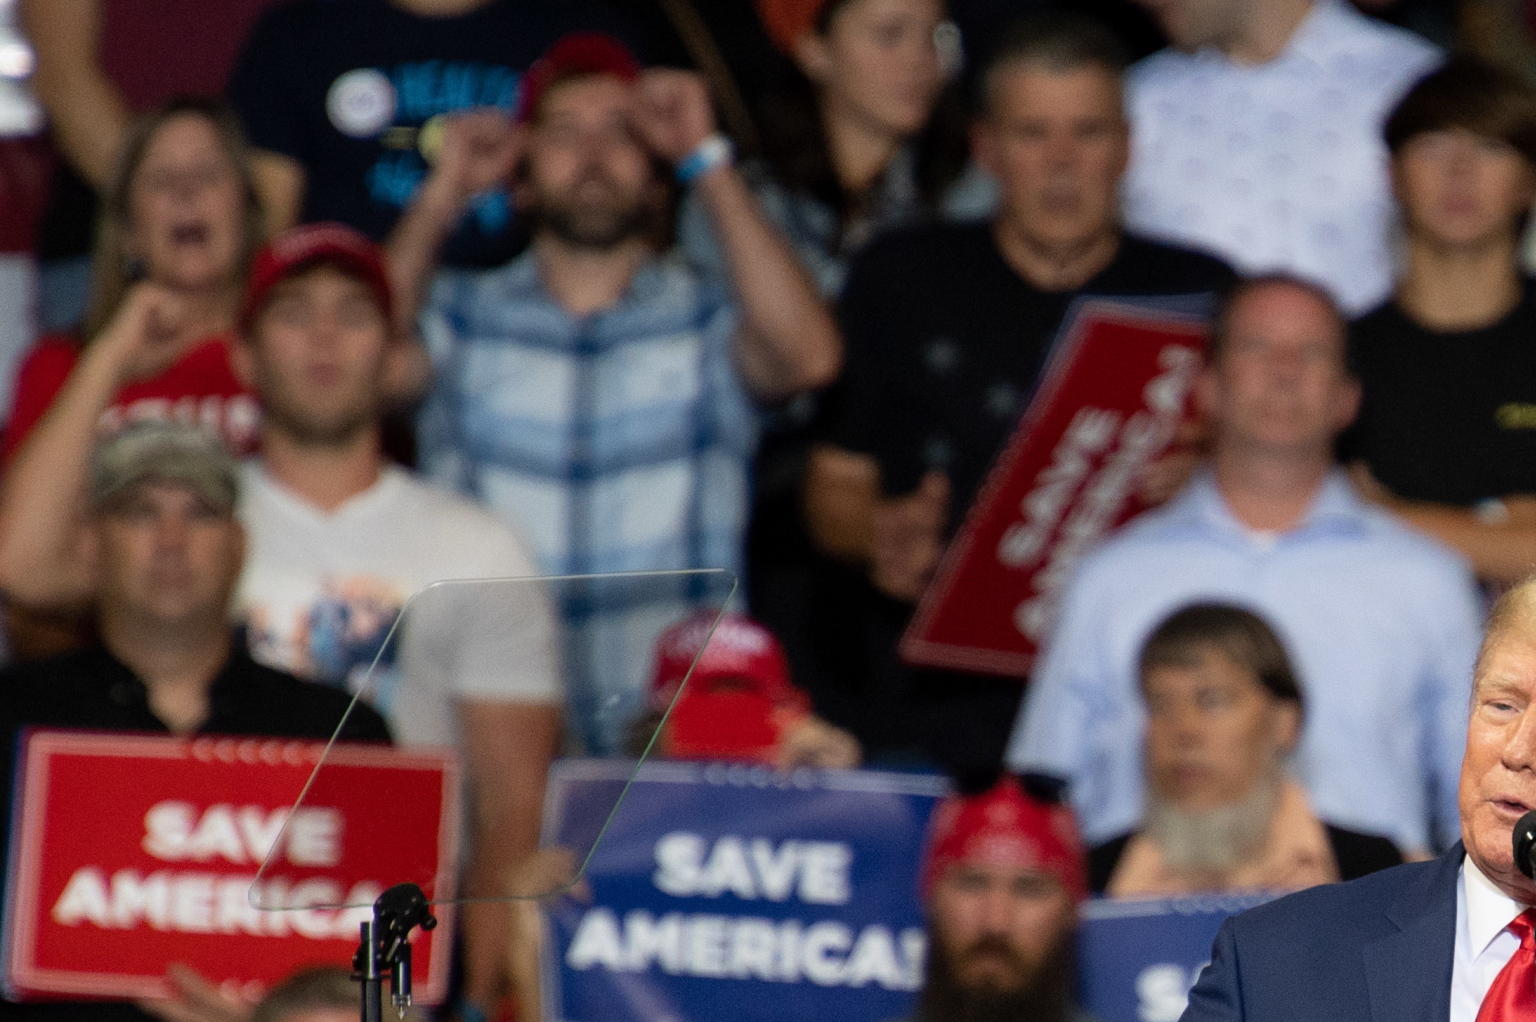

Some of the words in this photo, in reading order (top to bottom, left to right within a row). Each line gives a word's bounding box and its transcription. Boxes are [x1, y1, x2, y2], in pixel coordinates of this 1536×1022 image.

[142, 801, 347, 868] SAVE
[653, 831, 852, 905] SAVE
[565, 904, 929, 991] AMERICA!
